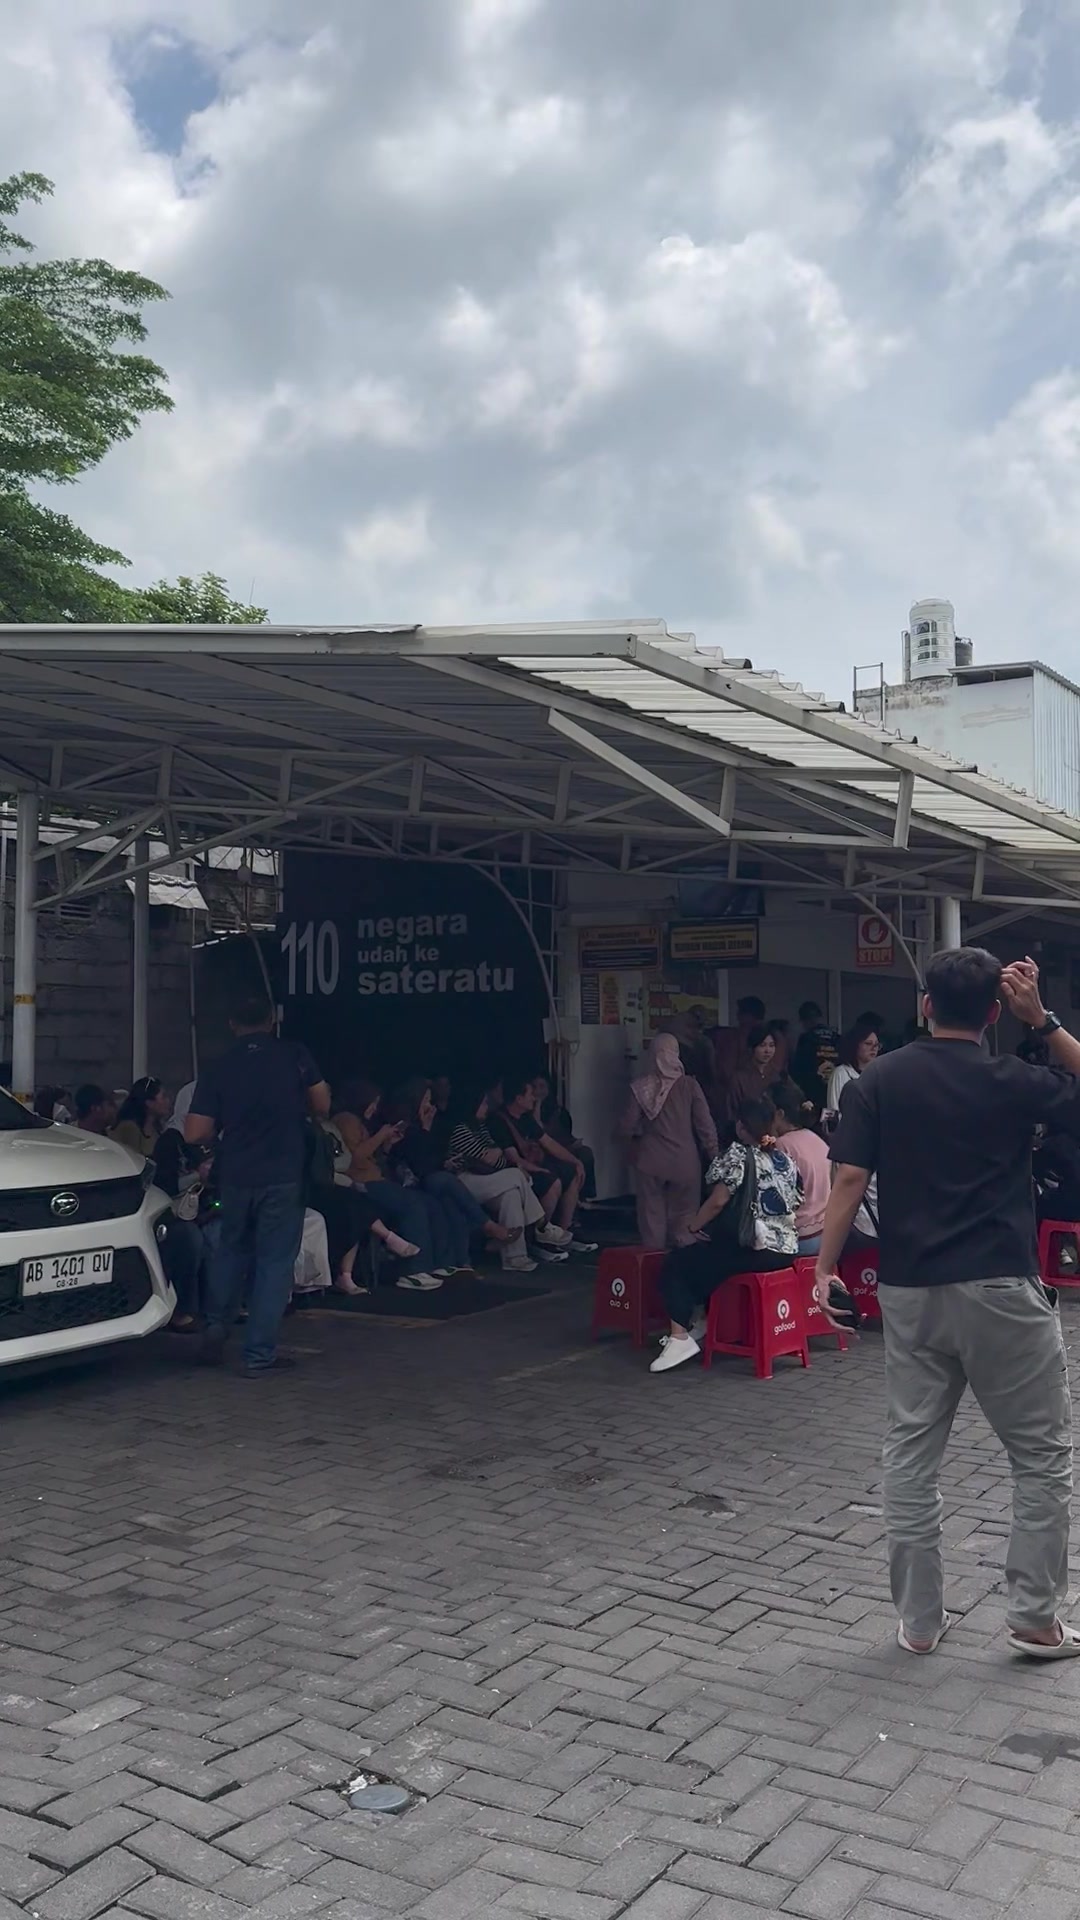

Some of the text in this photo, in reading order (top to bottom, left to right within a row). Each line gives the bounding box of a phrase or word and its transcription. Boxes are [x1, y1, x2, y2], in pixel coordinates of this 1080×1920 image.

[357, 913, 468, 944] negara
[281, 920, 340, 995] 110
[357, 944, 440, 963] udah ke
[859, 949, 893, 962] STOP!
[358, 961, 515, 995] sateratu
[26, 1253, 111, 1283] AB 1401 QV
[774, 1320, 796, 1336] gofood
